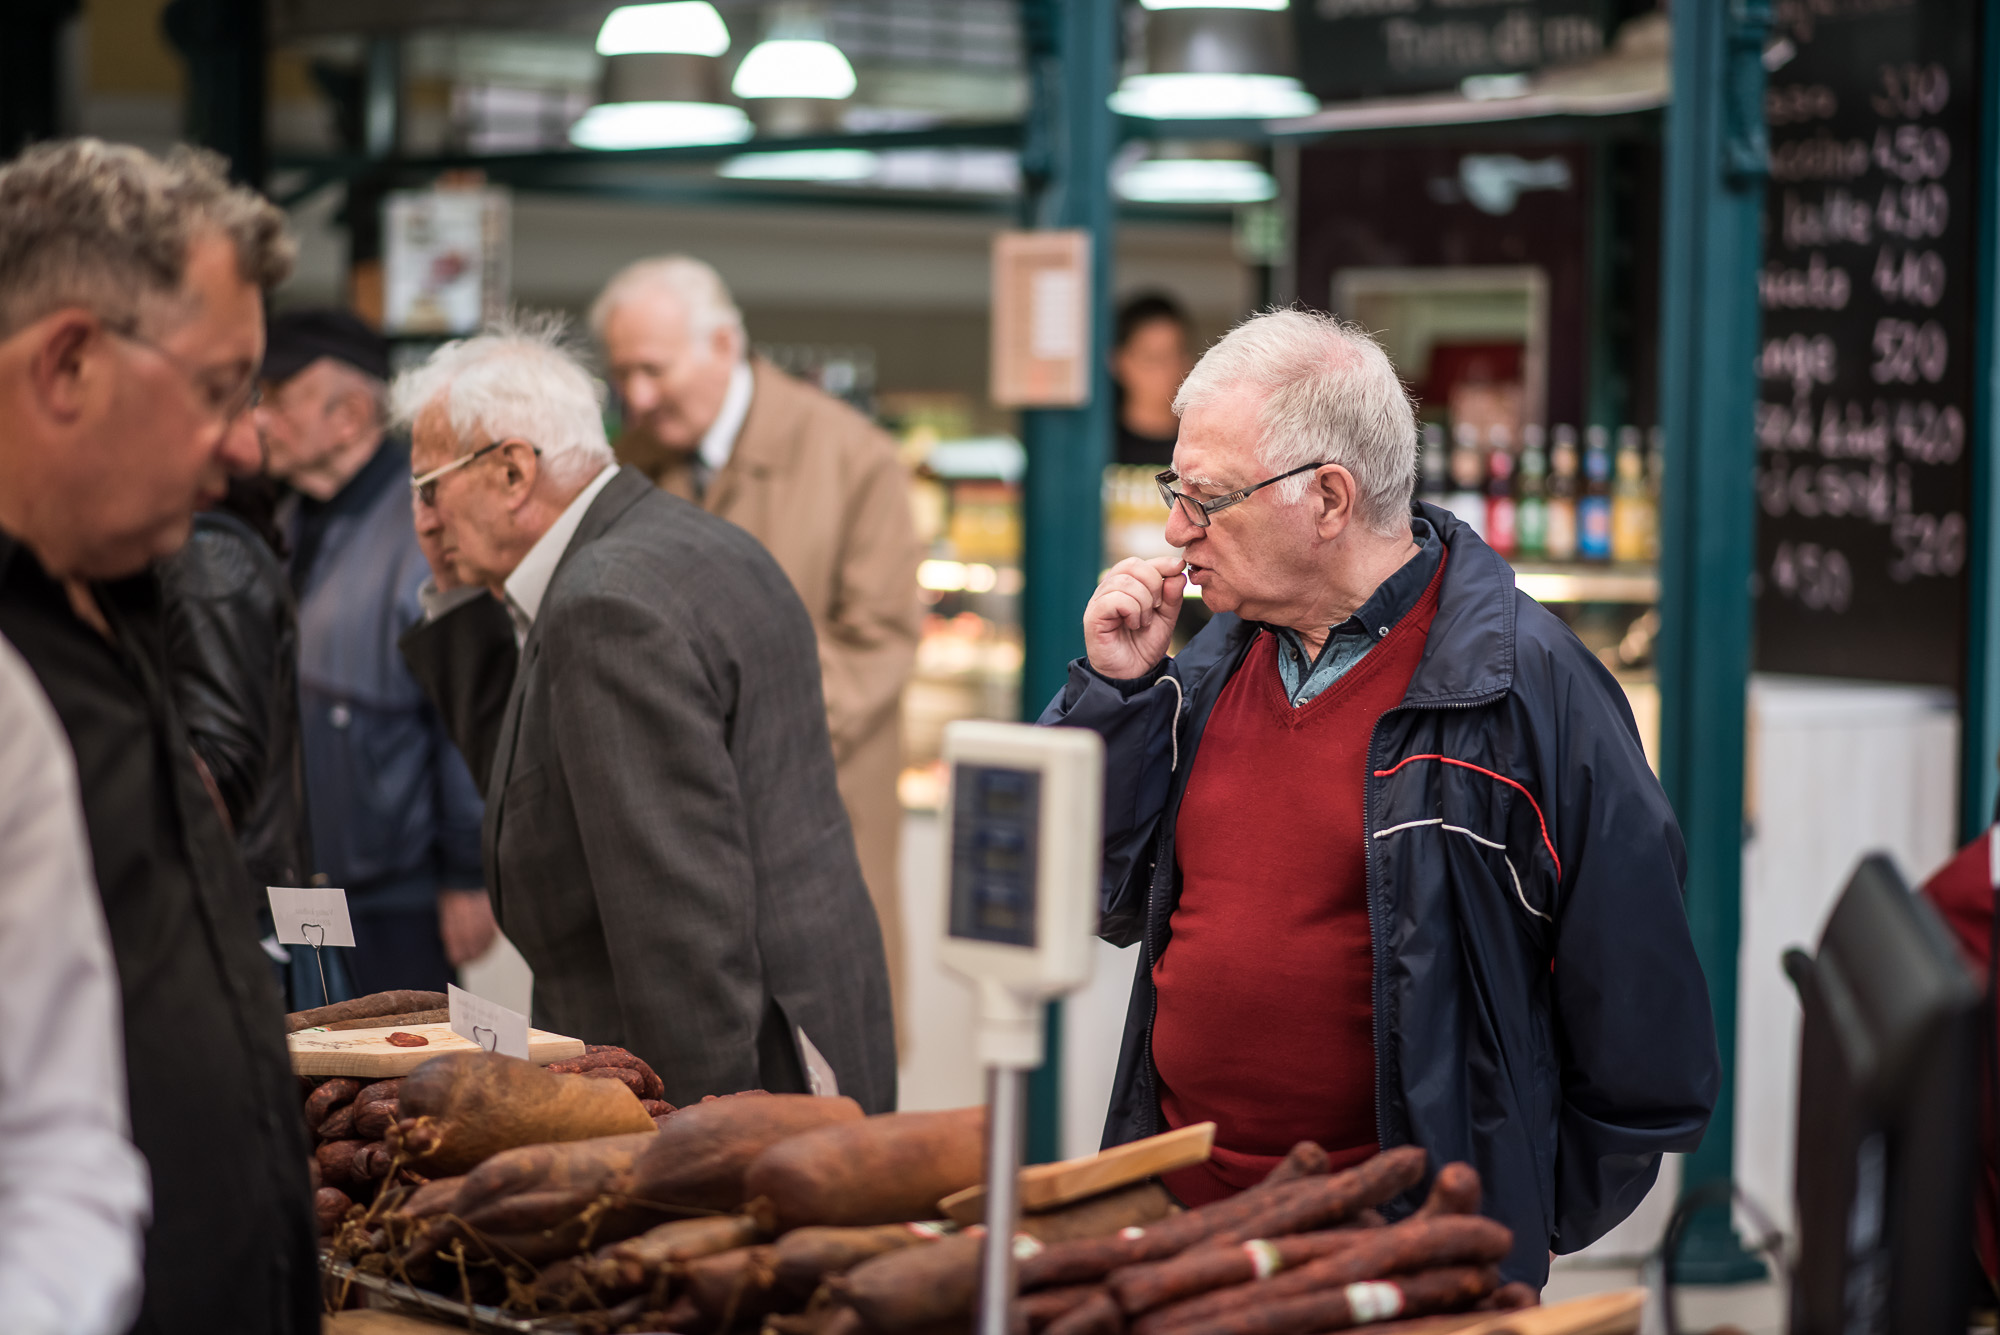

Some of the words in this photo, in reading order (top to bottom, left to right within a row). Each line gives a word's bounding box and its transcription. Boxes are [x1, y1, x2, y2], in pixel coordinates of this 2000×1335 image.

[1873, 124, 1949, 182] 450
[1871, 317, 1947, 385] 520
[1773, 540, 1851, 613] 450
[1890, 512, 1966, 582] 520
